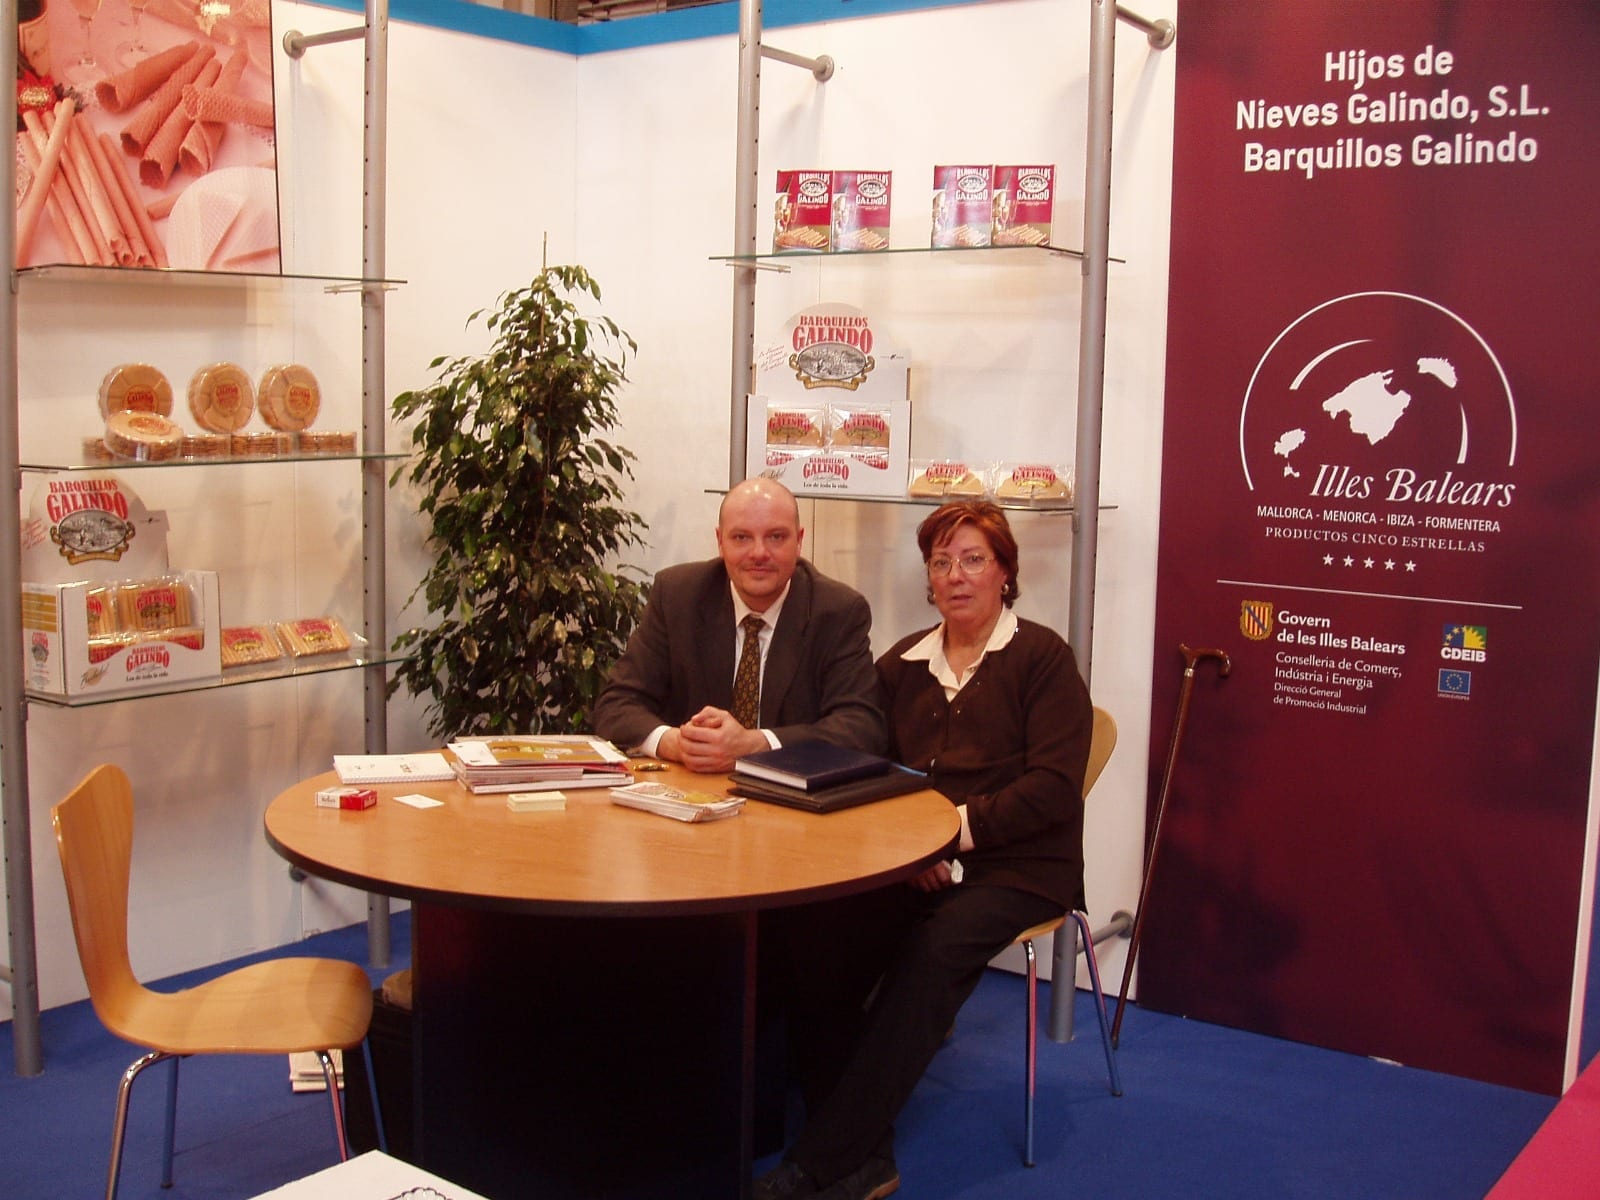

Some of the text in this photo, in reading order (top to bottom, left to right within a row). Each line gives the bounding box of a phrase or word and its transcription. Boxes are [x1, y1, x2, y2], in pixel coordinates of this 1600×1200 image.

[1325, 45, 1453, 89] Hijos de
[1236, 85, 1549, 130] Nieves Galindo, S.L.
[1244, 131, 1538, 179] Barquillos Galindo
[798, 193, 829, 204] GALINDO
[856, 194, 887, 205] GALINDO
[955, 189, 988, 200] GALINDO
[1017, 189, 1049, 200] GALINDO
[800, 315, 868, 327] BARQUILLOS
[792, 327, 873, 354] GALINDO
[803, 463, 850, 480] GALINDO
[49, 479, 119, 493] BARQUILLOS
[1310, 464, 1516, 507] Illes Balears
[47, 491, 128, 523] GALINDO
[1257, 505, 1313, 520] MALLORCA
[1323, 510, 1377, 524] MENORCA
[1387, 513, 1415, 527] IBIZA
[1425, 516, 1500, 532] FORMENTERA
[1265, 526, 1486, 552] PRODUCTOS CINCO ESTRELLAS
[1277, 610, 1331, 629] Govern
[1276, 629, 1406, 655] de les Illes Balears
[126, 650, 170, 672] GALINDO
[1275, 651, 1402, 678] Conselleria de Comerç,
[1440, 647, 1487, 663] CDEIB
[1275, 667, 1373, 690] Indústria i Energia
[1274, 682, 1342, 699] Direcció General
[1273, 694, 1367, 714] de Promoció Industrial
